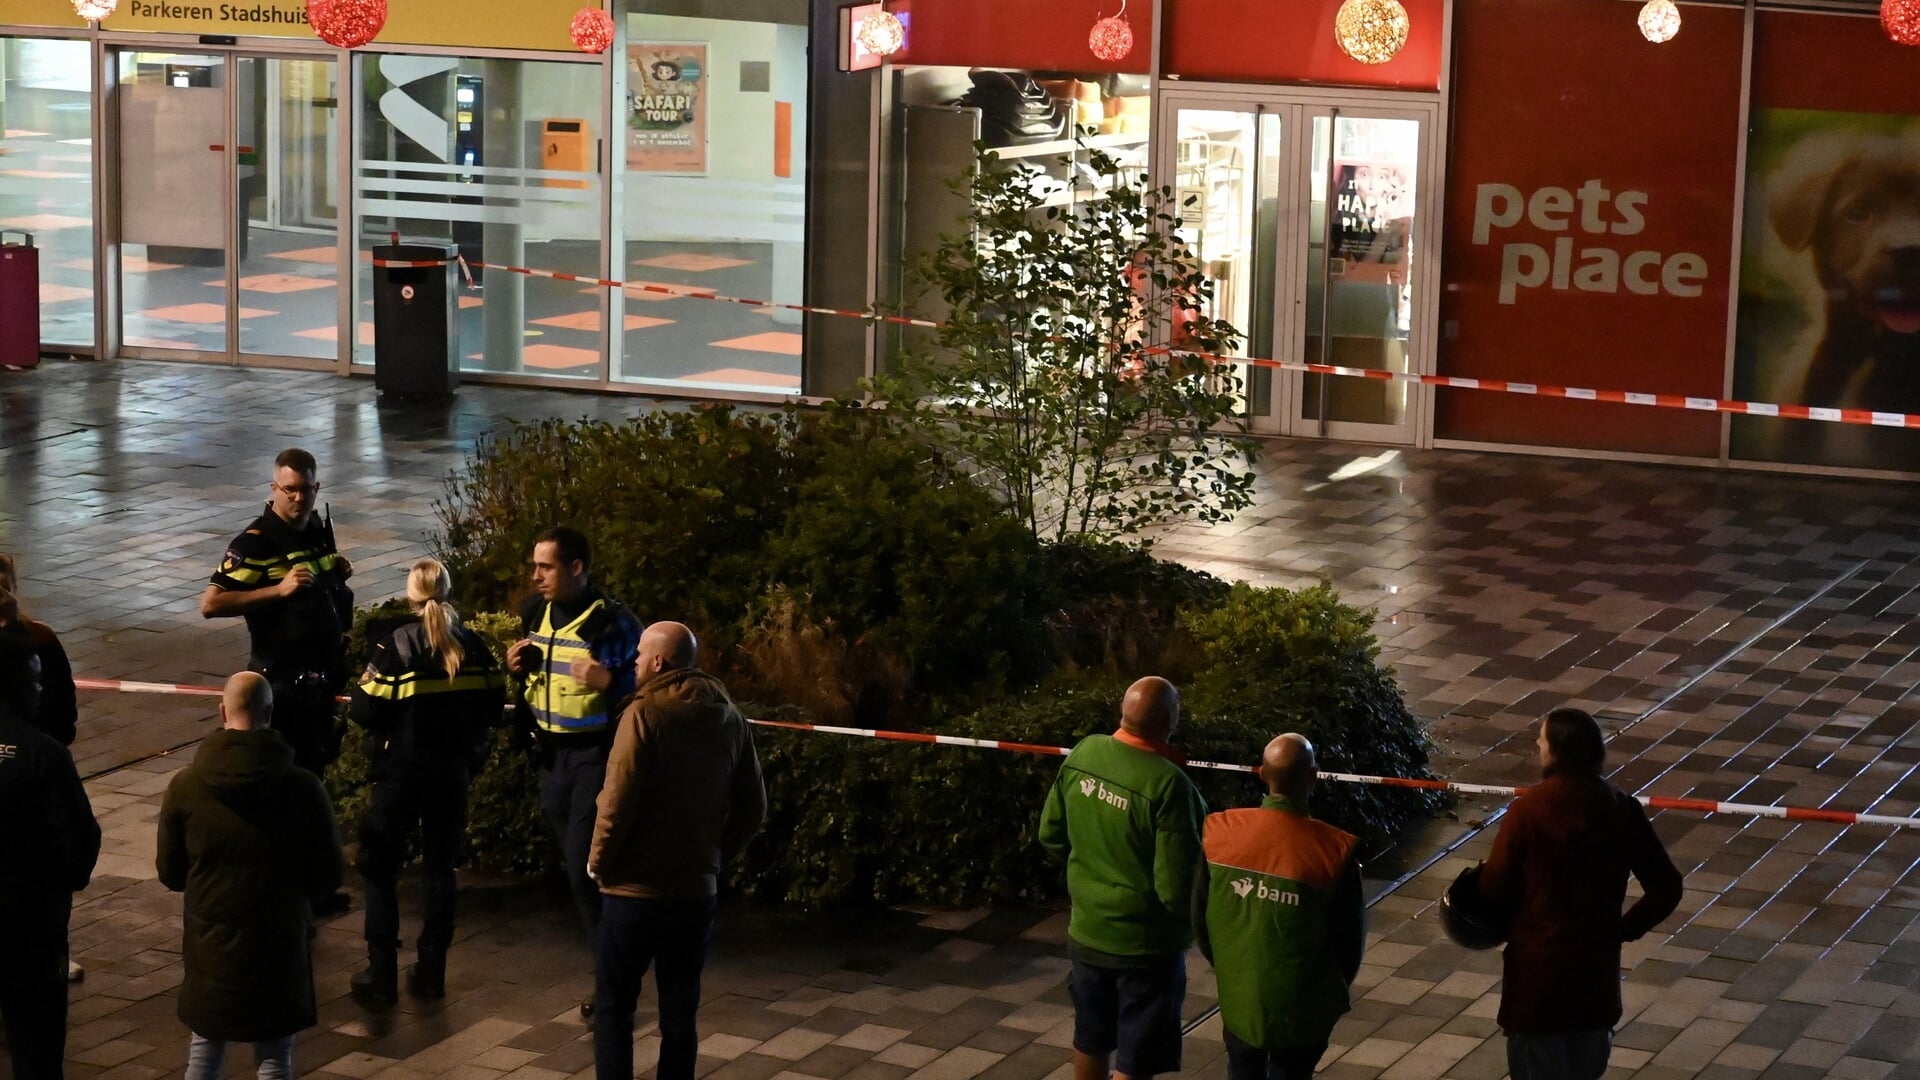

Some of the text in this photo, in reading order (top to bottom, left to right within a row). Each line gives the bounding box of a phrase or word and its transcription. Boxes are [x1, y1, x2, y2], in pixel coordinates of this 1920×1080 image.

[131, 1, 309, 25] Parkeren Stadshuis
[634, 95, 691, 110] SAFARI
[646, 110, 678, 121] TOUR
[1472, 179, 1648, 245] pets
[1498, 237, 1708, 304] place
[1098, 782, 1128, 811] bam
[1257, 880, 1300, 906] bam
